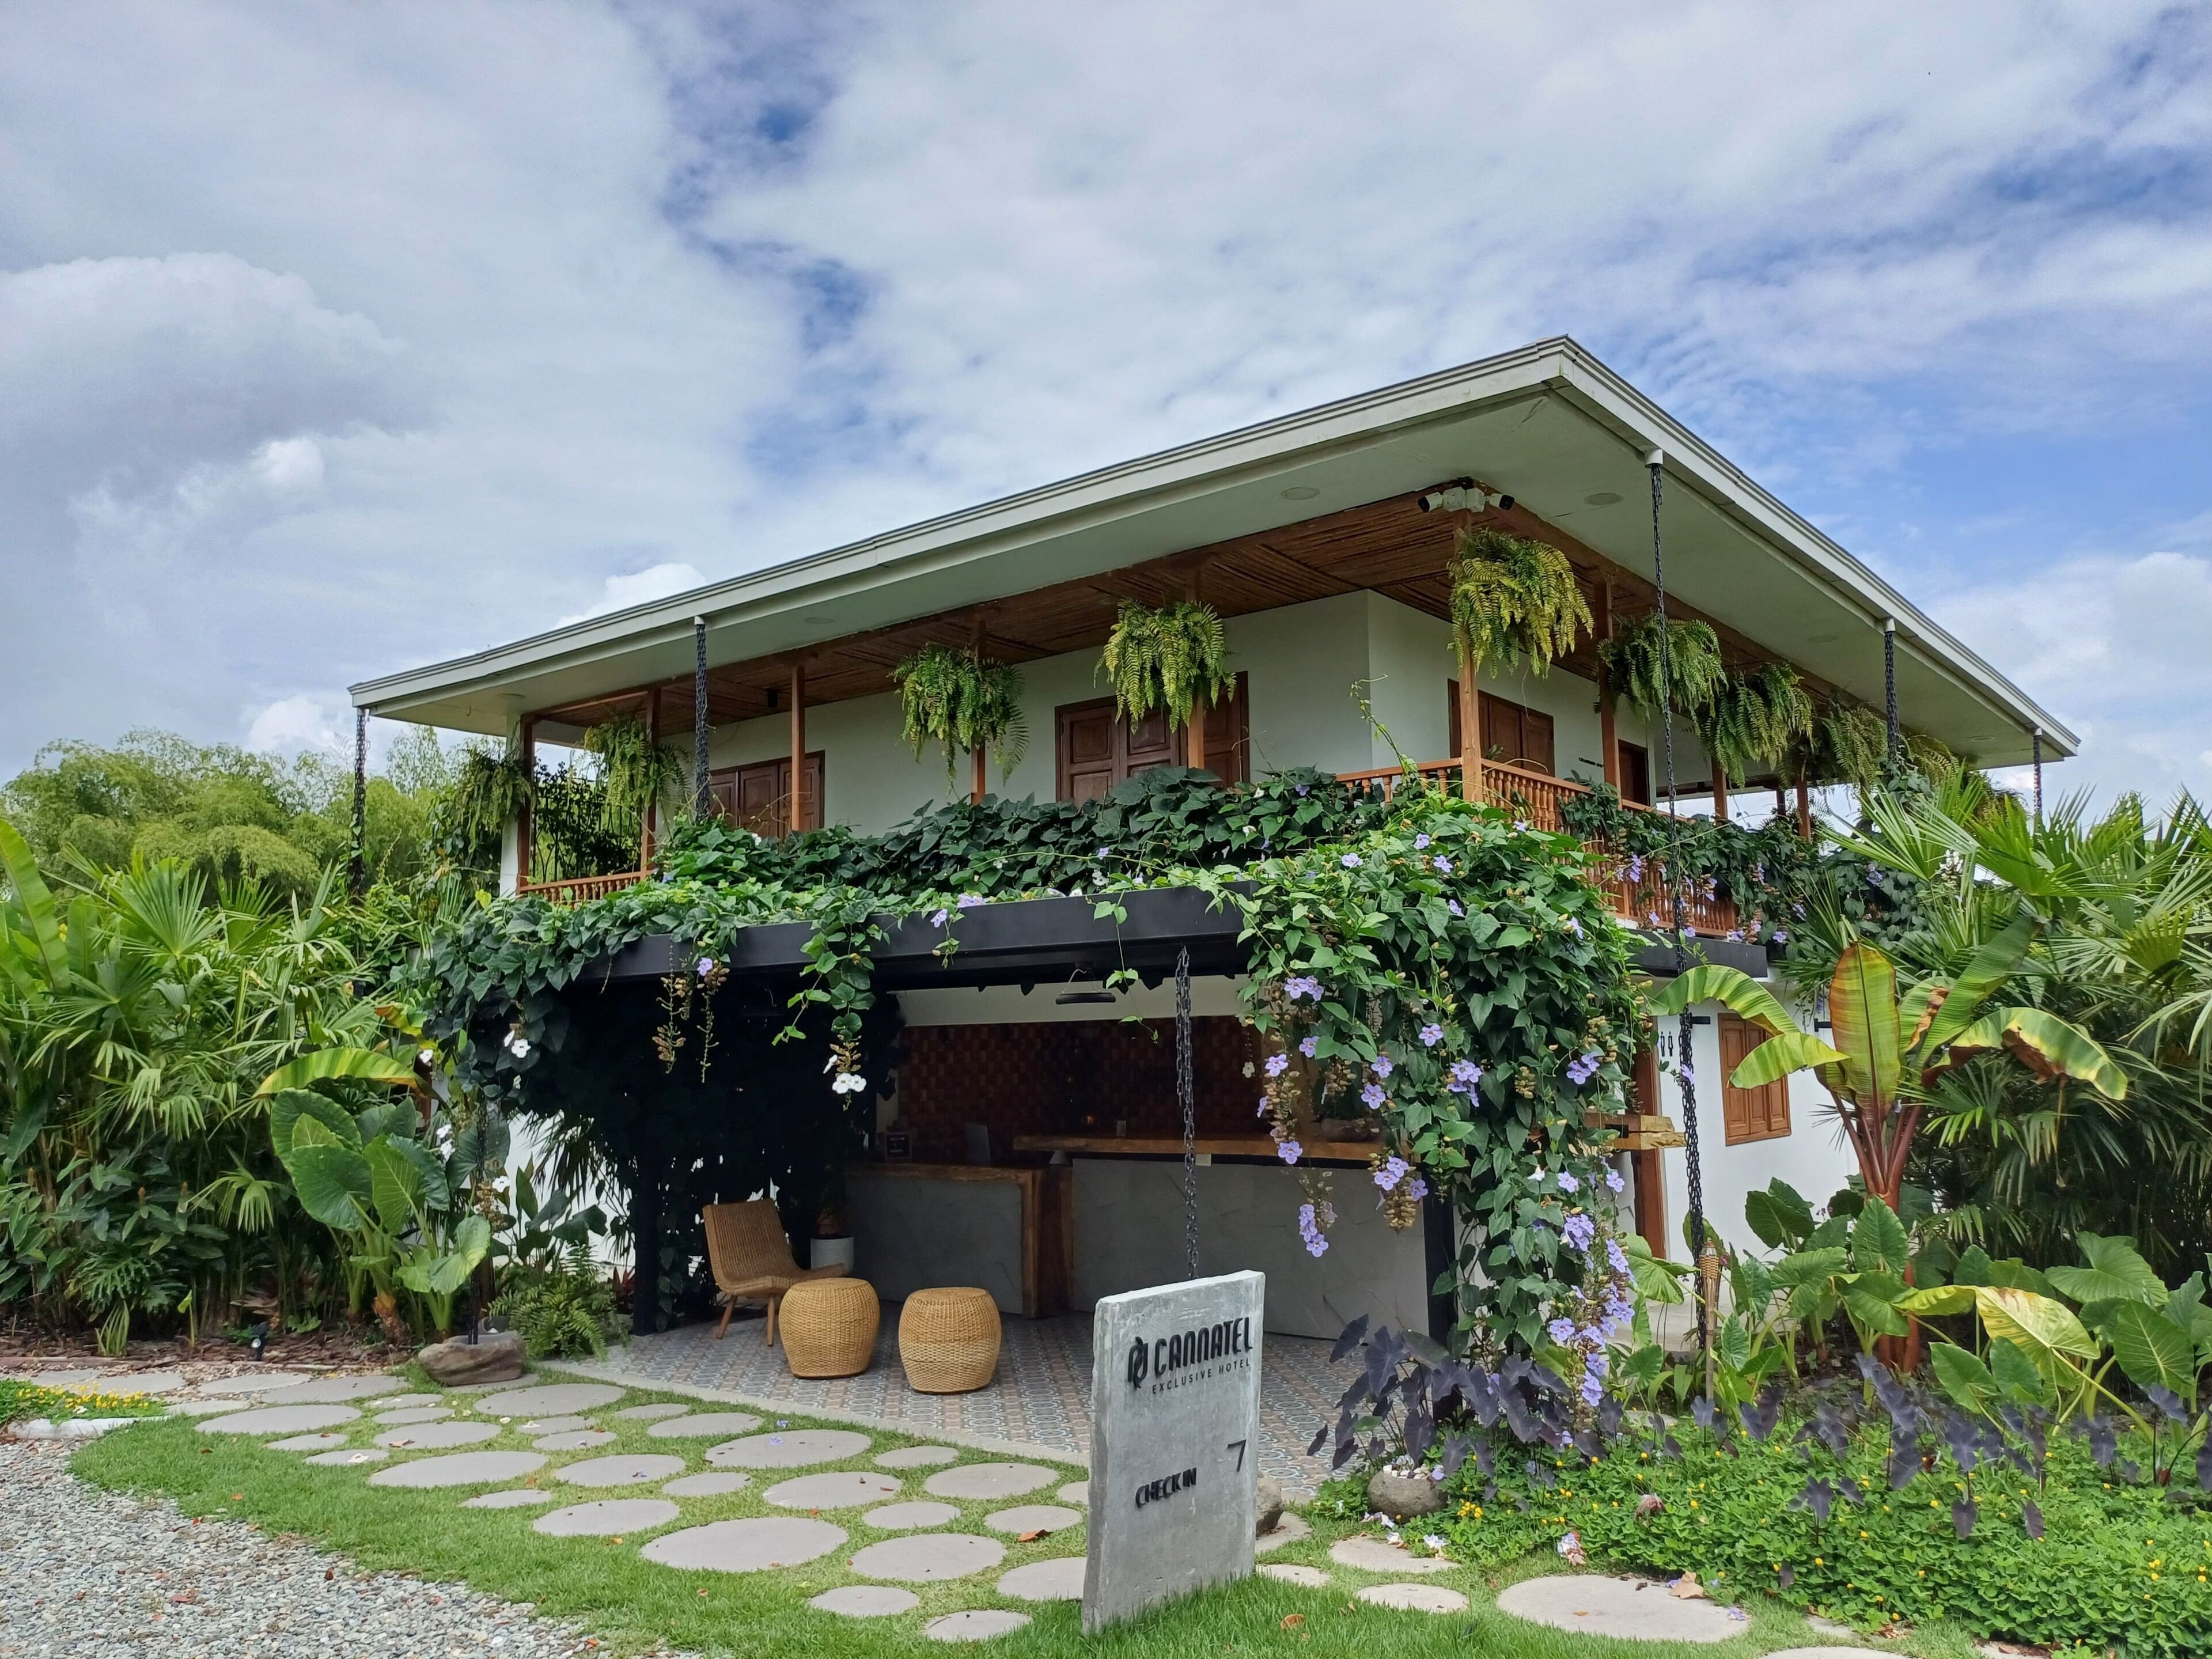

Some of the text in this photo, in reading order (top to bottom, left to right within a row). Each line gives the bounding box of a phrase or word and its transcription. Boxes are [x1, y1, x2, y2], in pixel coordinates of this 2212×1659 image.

[1154, 1317, 1252, 1377] CANNATEL
[1152, 1357, 1250, 1395] EXCLUSIVE HOTEL
